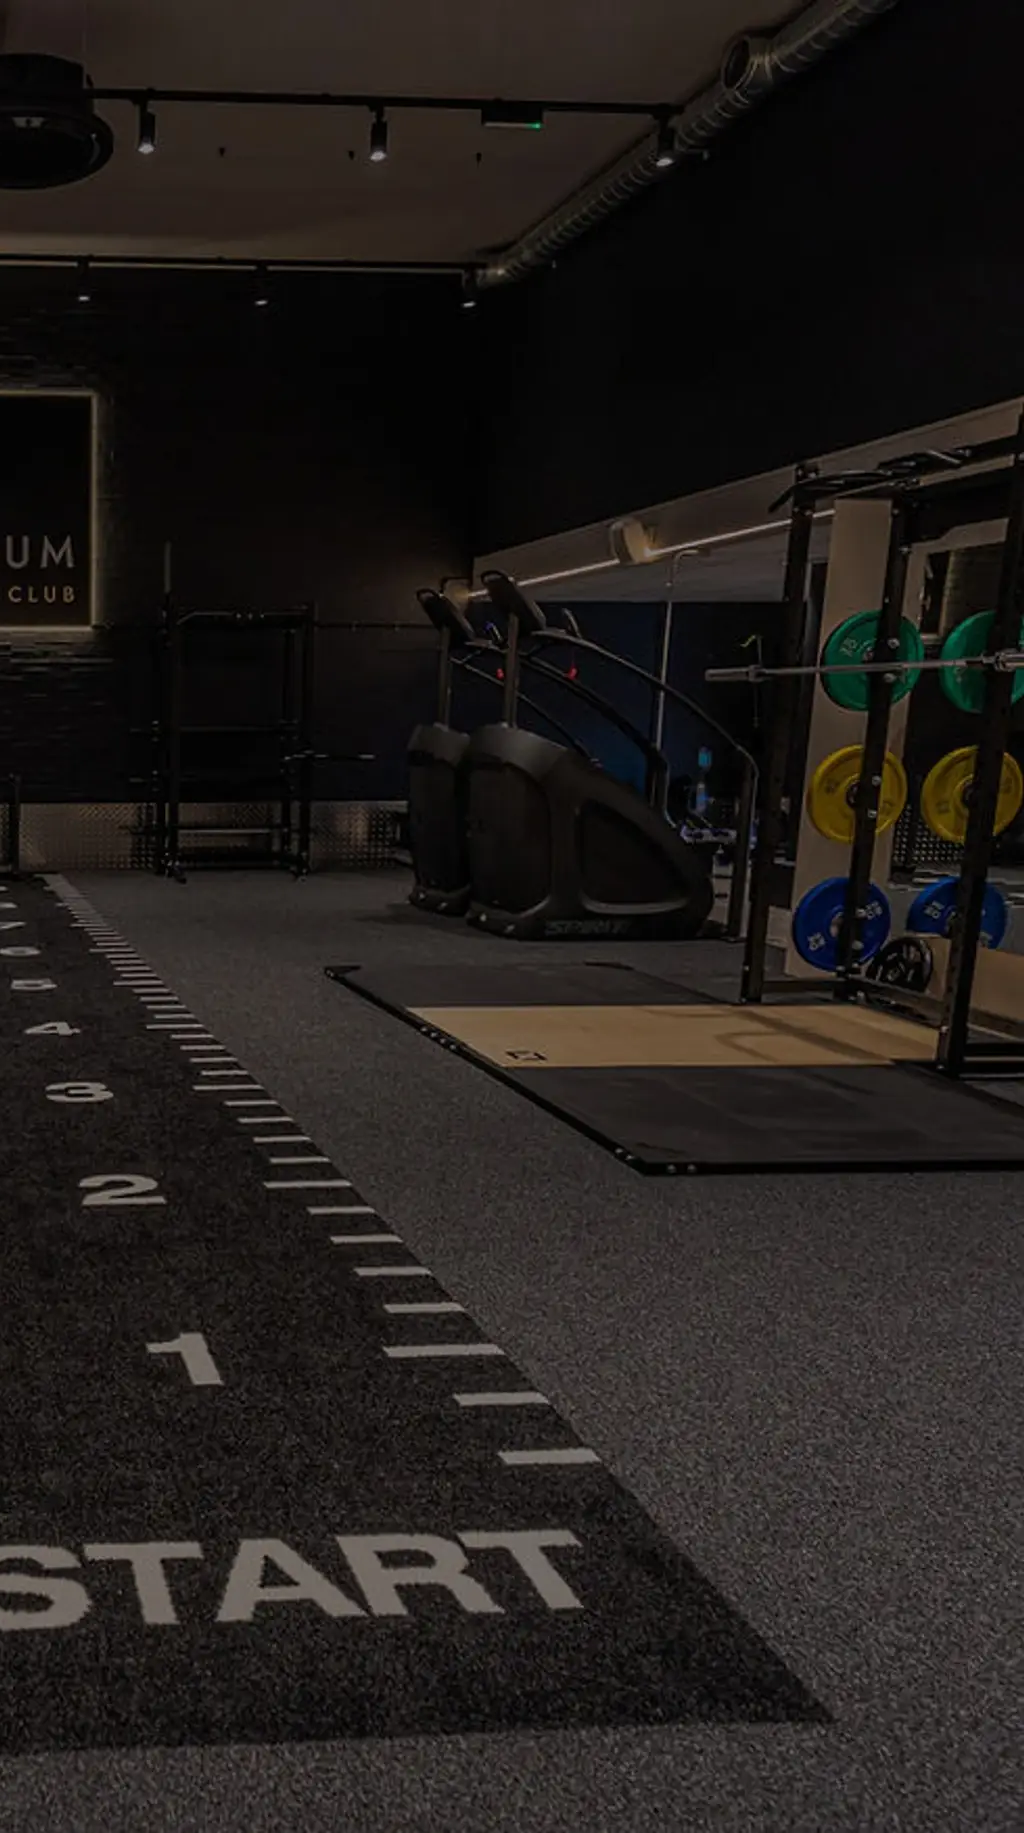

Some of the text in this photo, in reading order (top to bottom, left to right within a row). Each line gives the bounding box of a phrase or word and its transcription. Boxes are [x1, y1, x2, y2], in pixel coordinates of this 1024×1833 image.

[7, 584, 76, 604] CLUB
[23, 1020, 81, 1036] 4
[45, 1081, 115, 1104] 3
[78, 1173, 168, 1207] 2
[145, 1331, 226, 1387] 1
